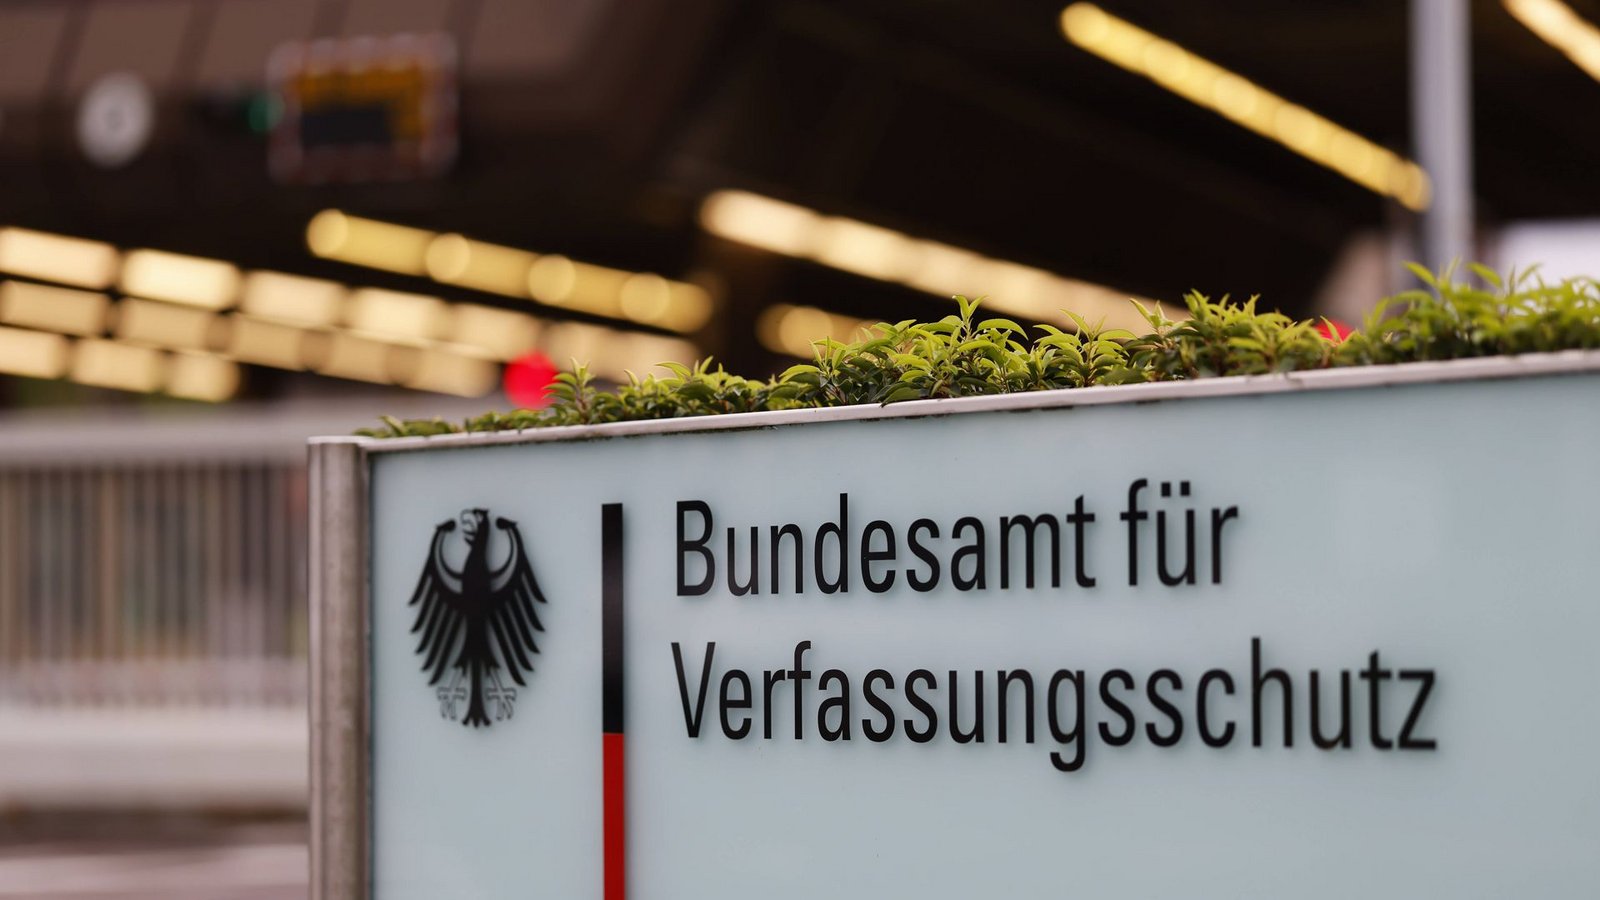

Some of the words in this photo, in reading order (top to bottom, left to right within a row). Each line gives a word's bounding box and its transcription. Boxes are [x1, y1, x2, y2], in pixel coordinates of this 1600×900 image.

[676, 492, 1097, 597] Bundesamt
[1119, 478, 1239, 588] für
[671, 637, 1438, 773] Verfassungsschutz
